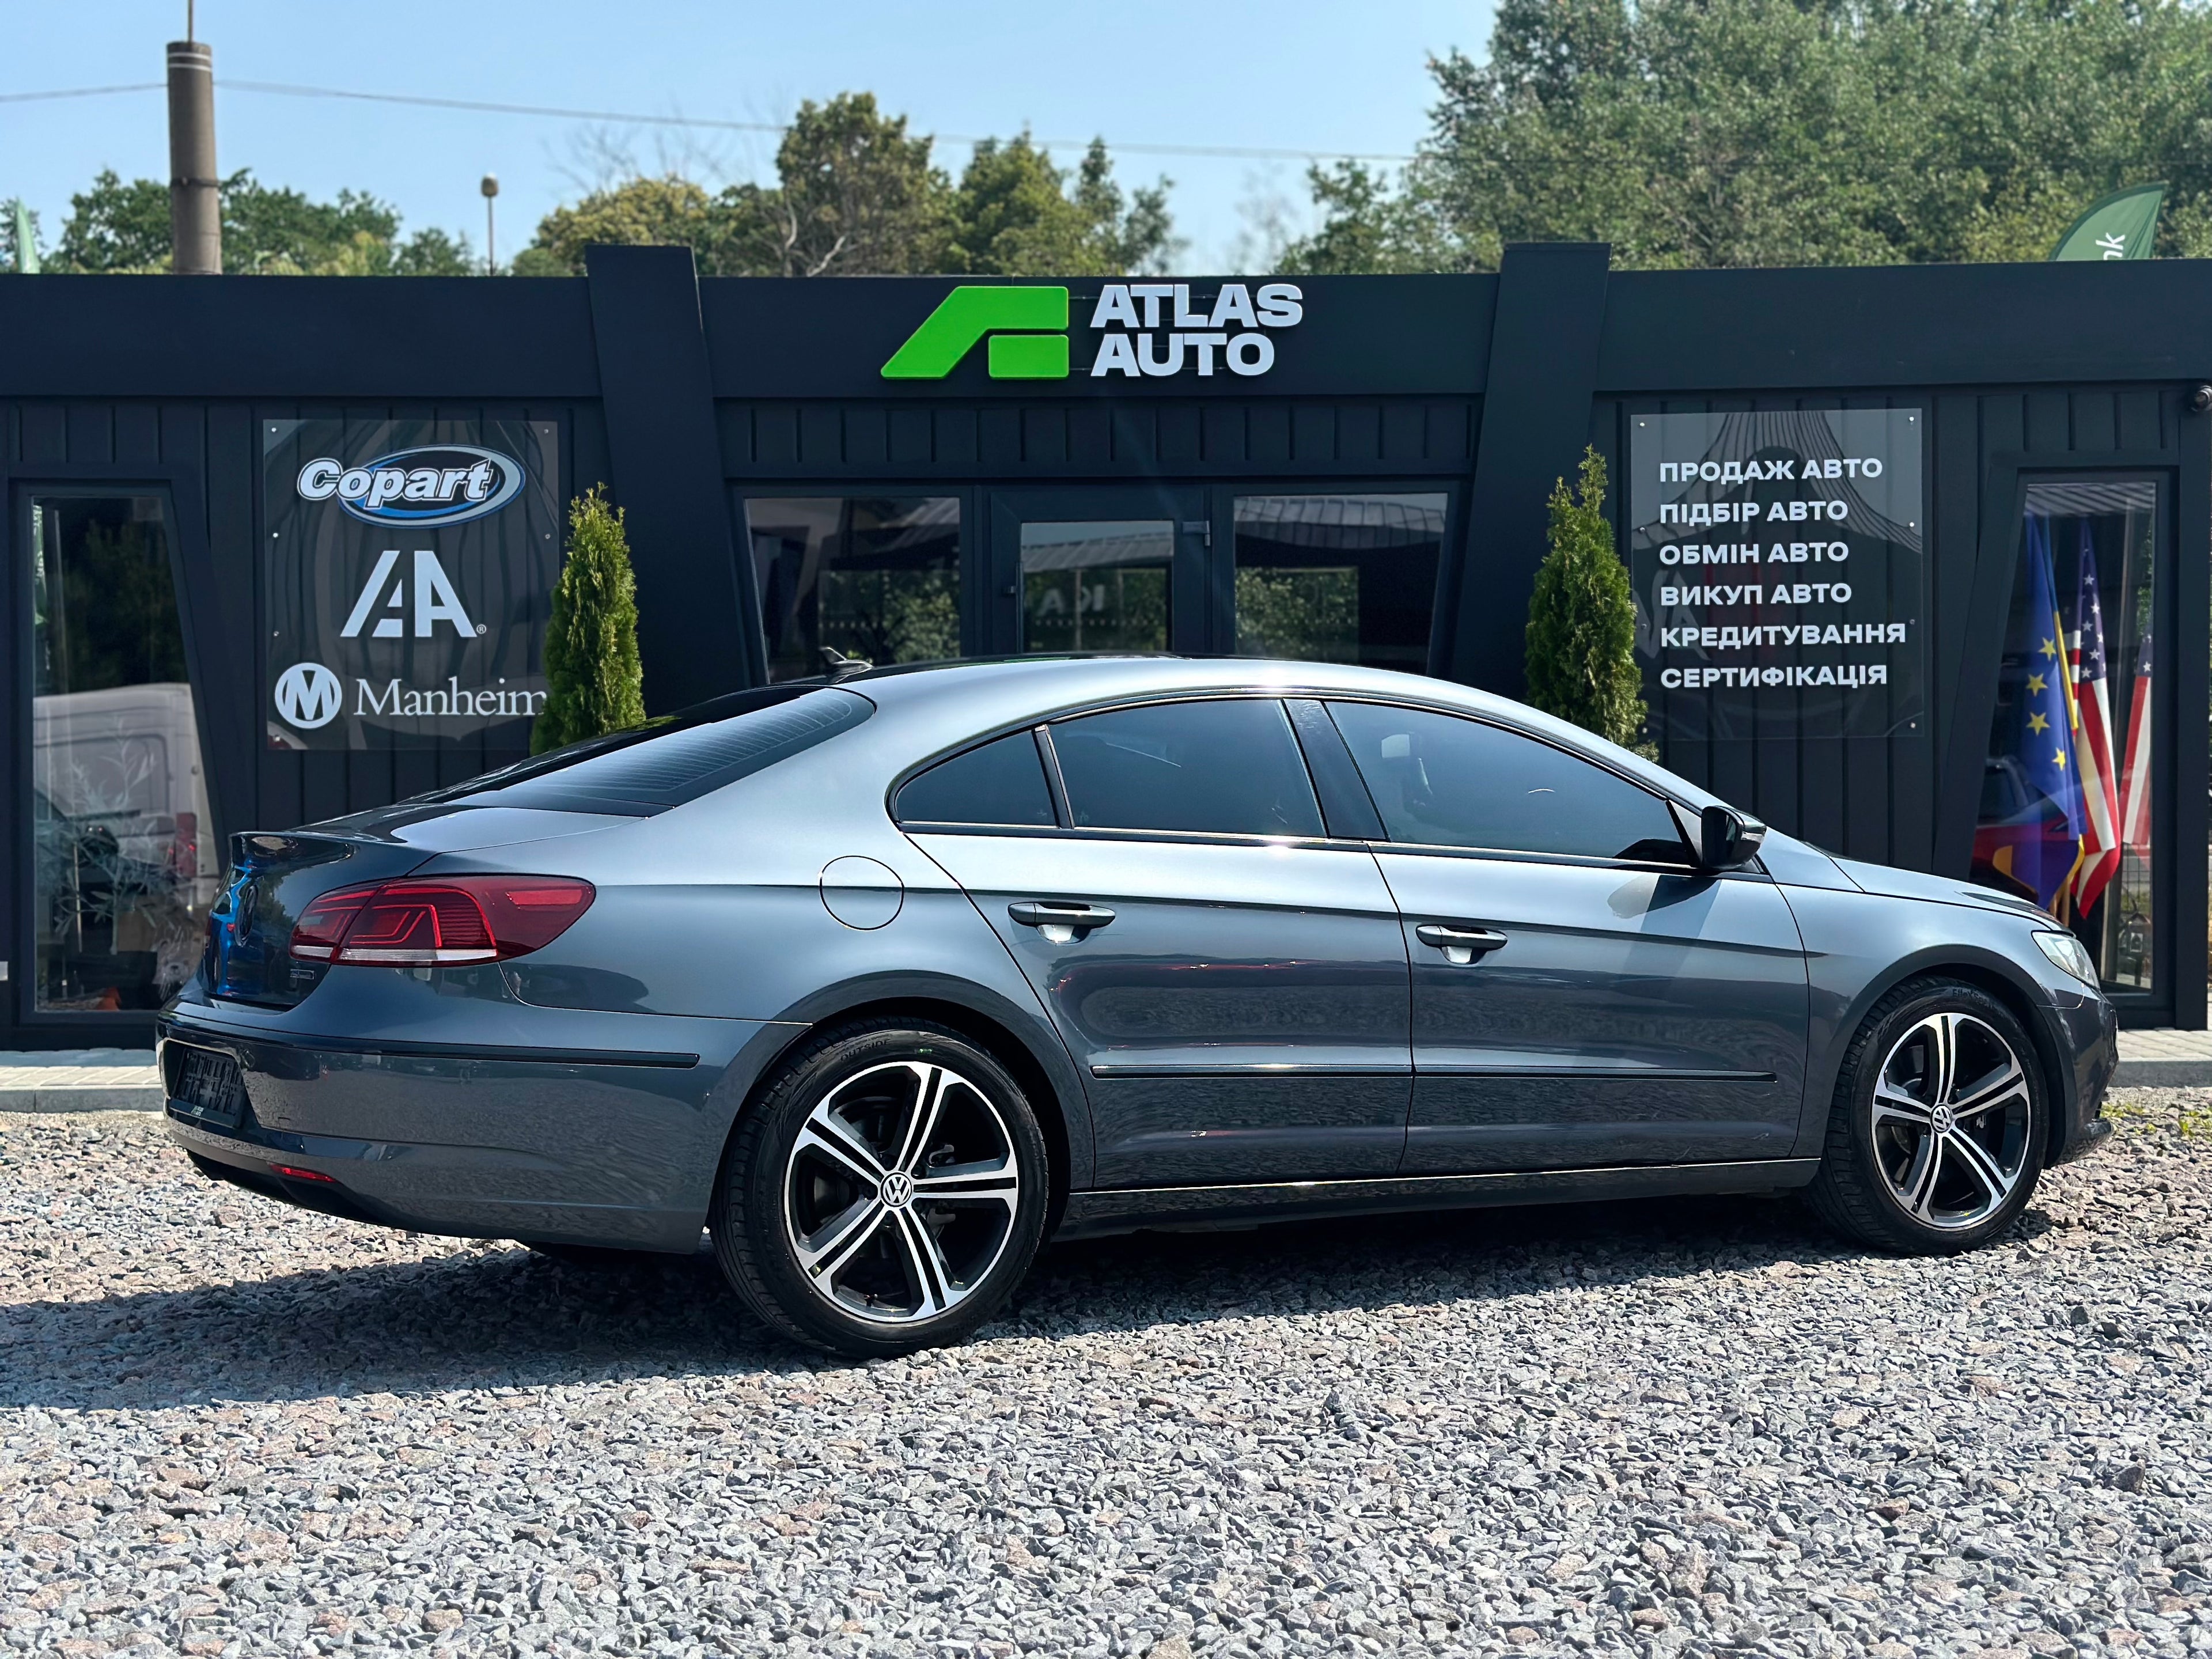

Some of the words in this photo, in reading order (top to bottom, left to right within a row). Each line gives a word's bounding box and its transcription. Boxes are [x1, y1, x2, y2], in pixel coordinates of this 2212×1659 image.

[1090, 283, 1303, 328] ATLAS
[1090, 332, 1275, 377] AUTO
[297, 457, 494, 509] Copart
[1660, 460, 1795, 485] ПРОДАЖ
[1801, 457, 1883, 479] АВТО
[1660, 502, 1760, 527] ПІДБІР
[1767, 500, 1849, 521] АВТО
[1660, 544, 1759, 565] ОБМІН
[1767, 541, 1849, 563] АВТО
[1660, 585, 1763, 606] ВИКУП
[1770, 583, 1852, 604] АВТО
[1661, 623, 1906, 650] КРЕДИТУВАННЯ
[1660, 665, 1887, 688] СЕРТИФІКАЦІЯ
[353, 676, 547, 716] Manheim
